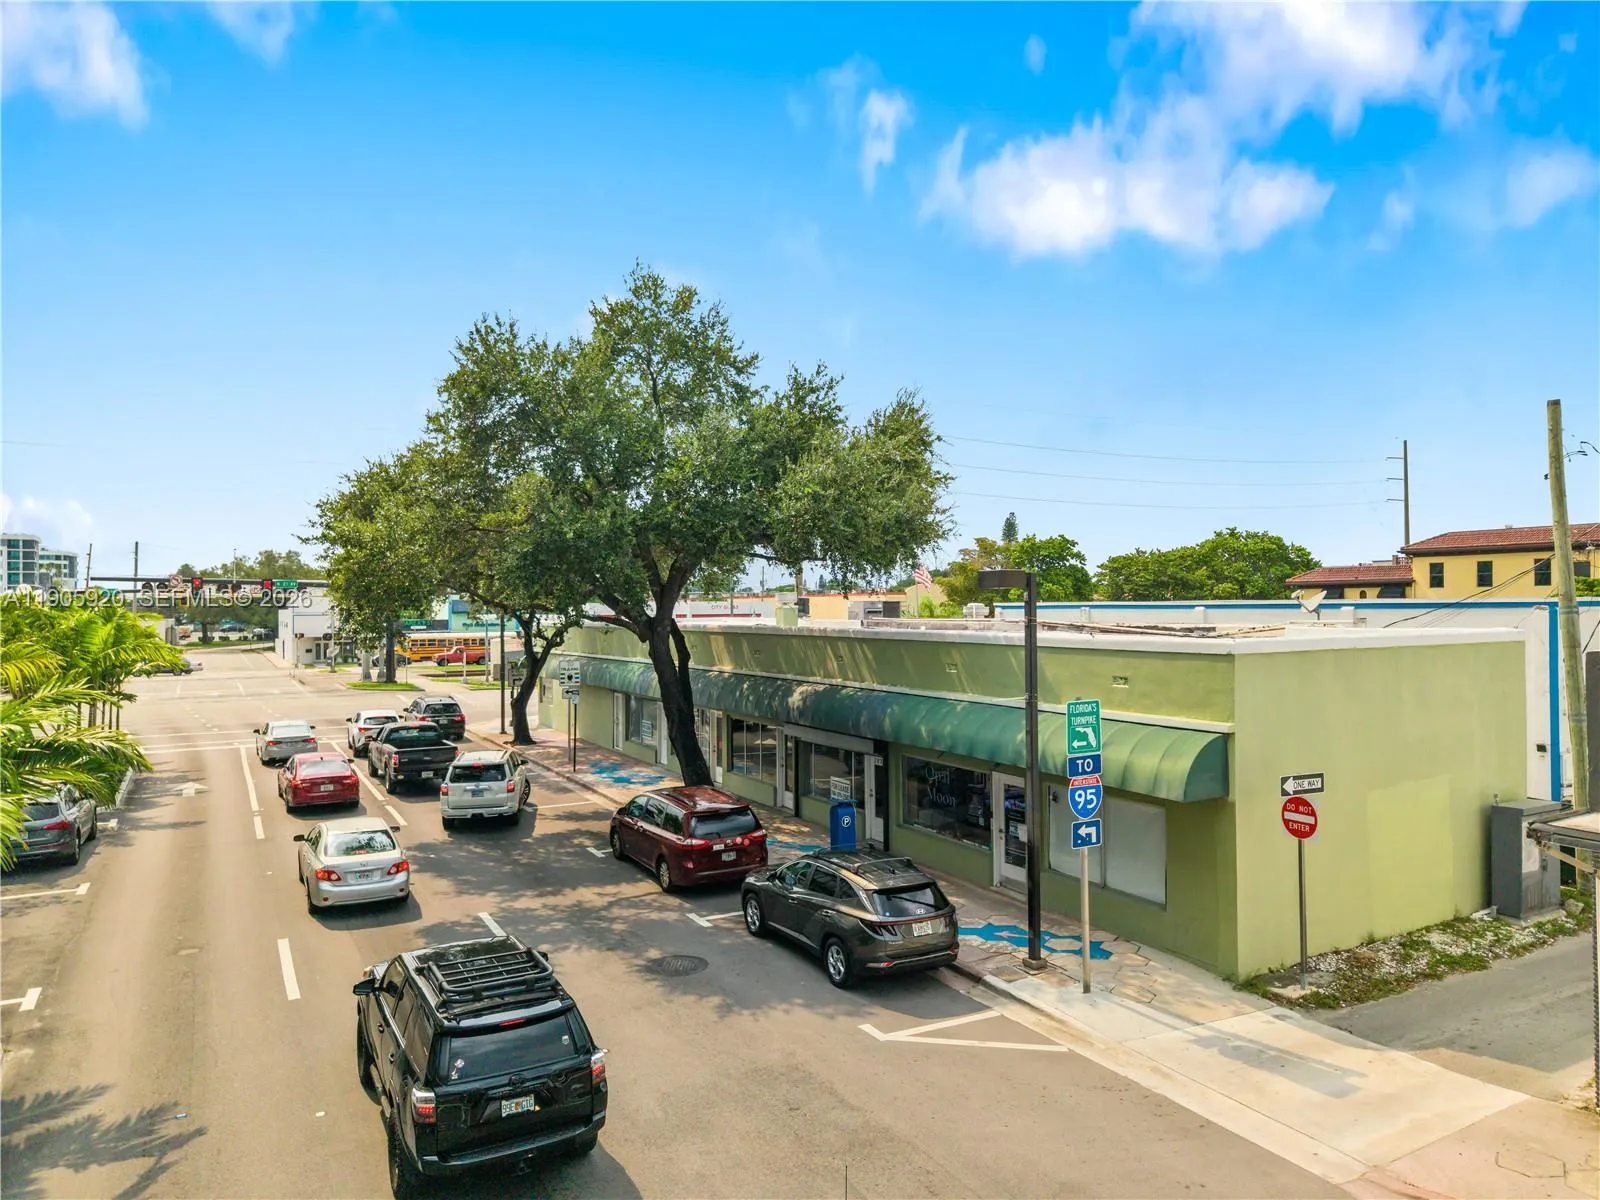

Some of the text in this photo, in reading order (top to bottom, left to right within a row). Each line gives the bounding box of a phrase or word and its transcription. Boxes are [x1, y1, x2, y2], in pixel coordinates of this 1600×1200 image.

[1069, 703, 1097, 714] FLORIDA'S
[1071, 715, 1097, 726] TURNPIKE
[1076, 758, 1093, 772] TO
[1293, 779, 1319, 789] ONE WAY
[1074, 788, 1097, 809] 95
[1286, 803, 1312, 814] DO NOT
[1288, 821, 1310, 832] ENTER
